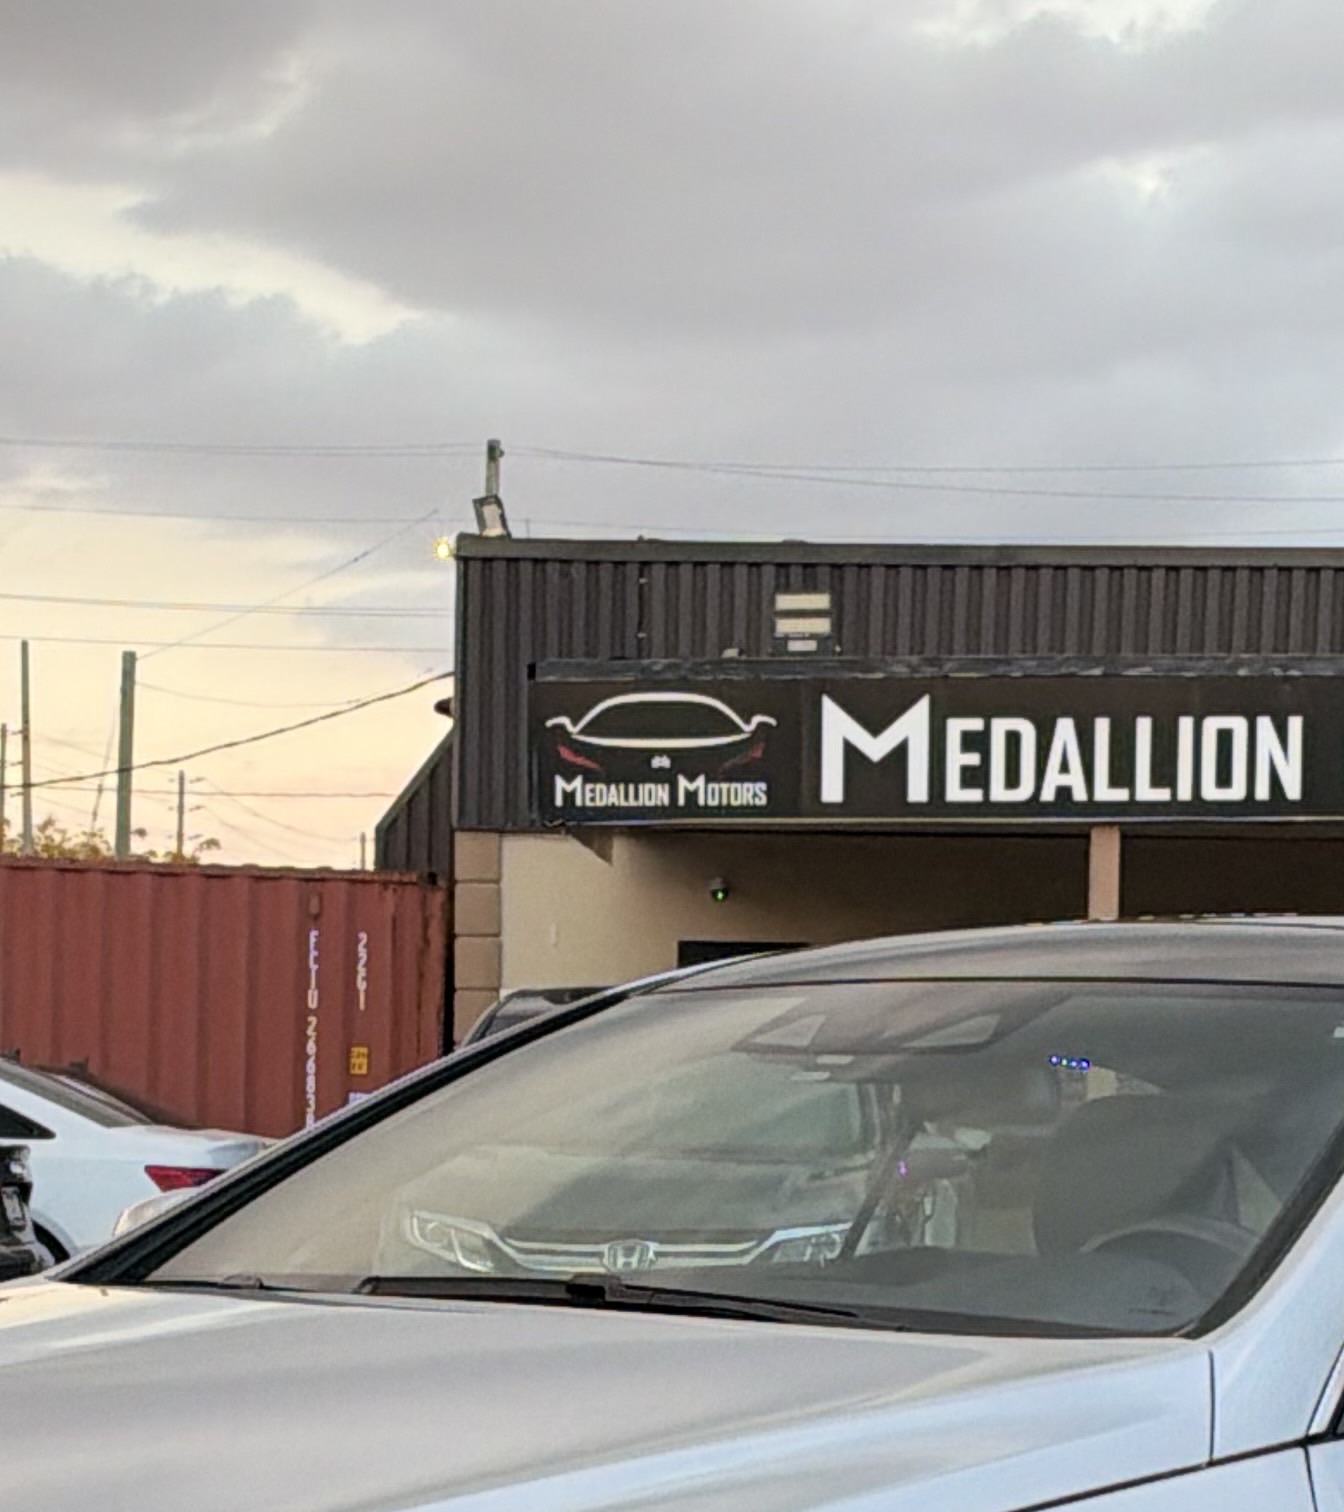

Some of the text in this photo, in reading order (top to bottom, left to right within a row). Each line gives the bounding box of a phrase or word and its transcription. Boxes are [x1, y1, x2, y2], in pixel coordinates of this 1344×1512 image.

[820, 692, 1304, 804] MEDALLION
[554, 773, 768, 807] MEDALLION MOTORS
